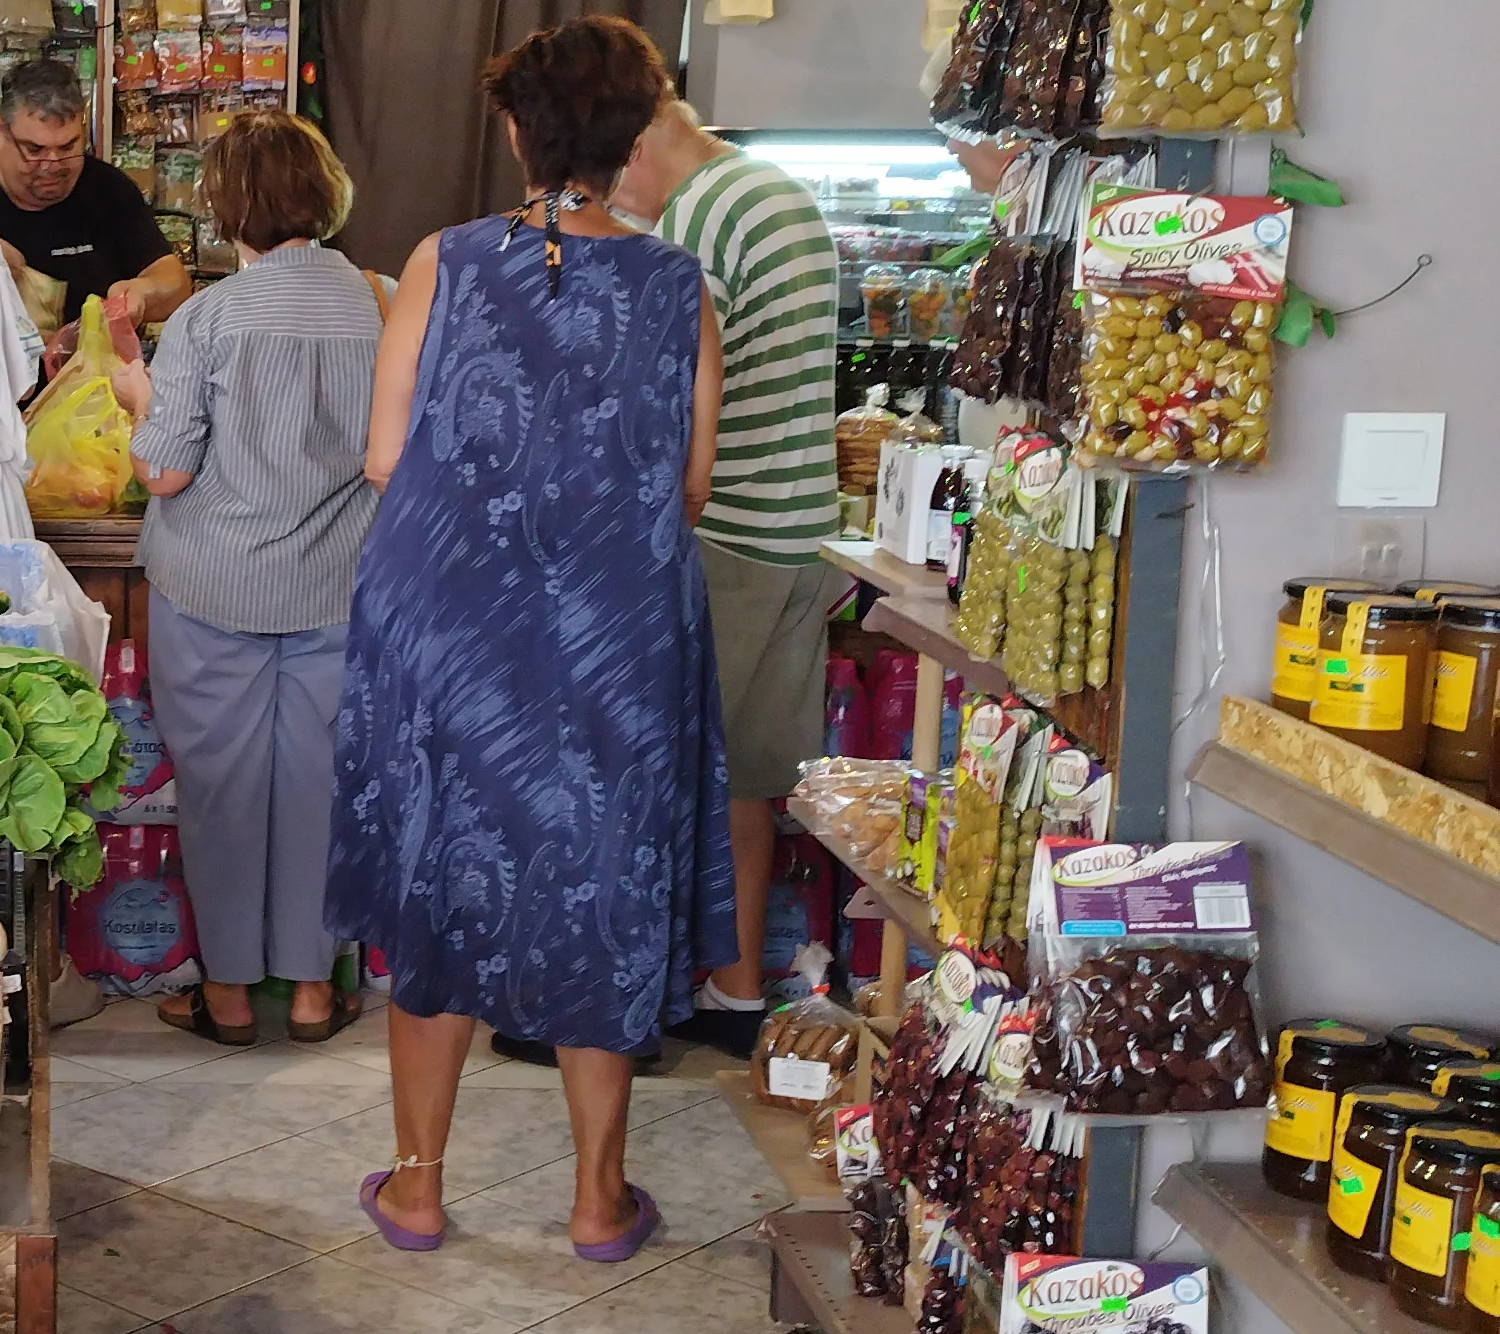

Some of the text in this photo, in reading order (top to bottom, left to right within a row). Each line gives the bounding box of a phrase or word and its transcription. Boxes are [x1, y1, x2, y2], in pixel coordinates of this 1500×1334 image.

[1126, 242, 1243, 268] Spicy Olives
[1057, 847, 1138, 878] Kazakos
[1028, 1268, 1145, 1308] Kazakos
[1041, 1300, 1176, 1334] Throubes Olives
